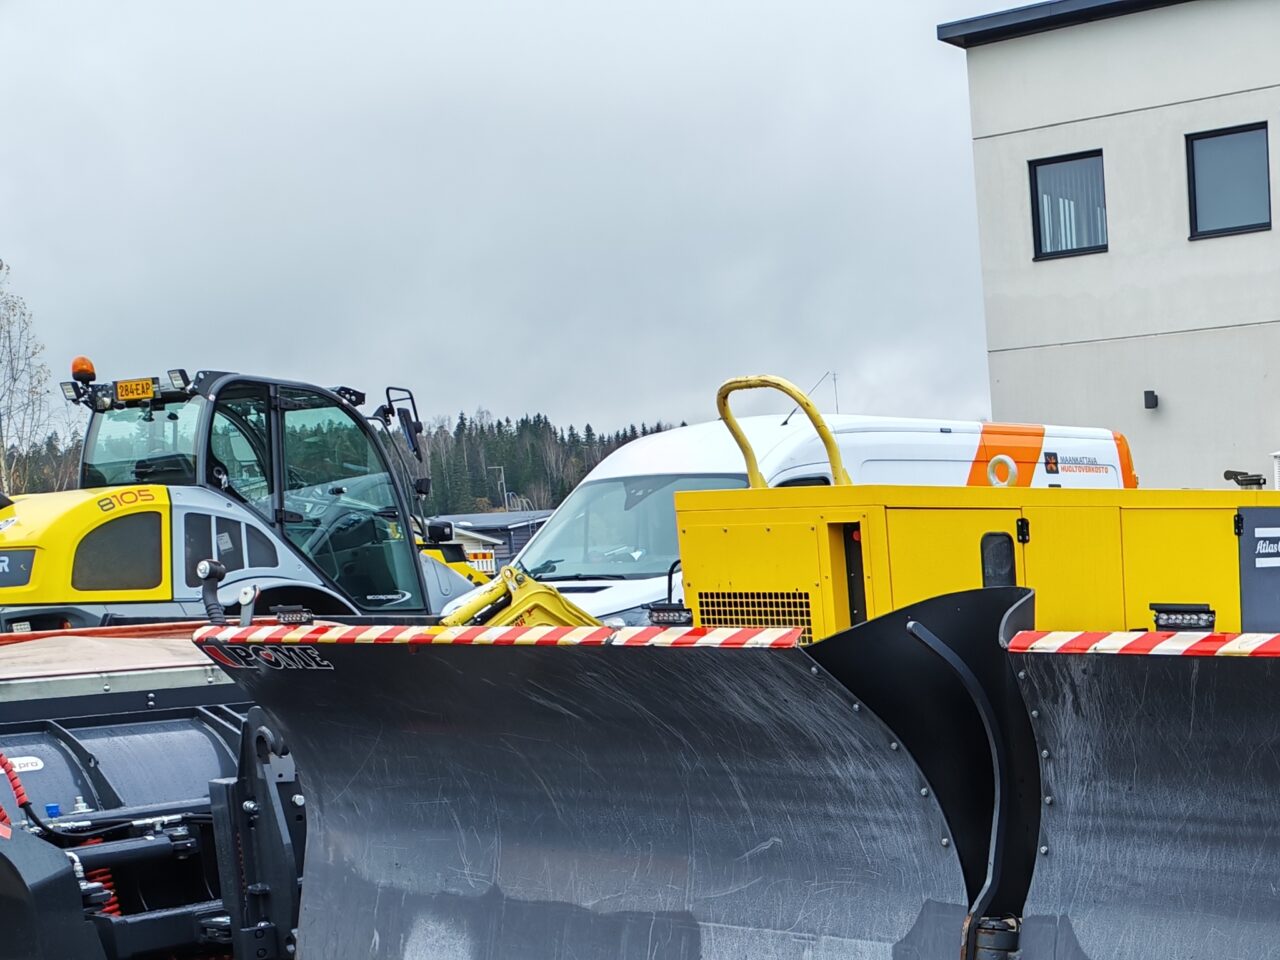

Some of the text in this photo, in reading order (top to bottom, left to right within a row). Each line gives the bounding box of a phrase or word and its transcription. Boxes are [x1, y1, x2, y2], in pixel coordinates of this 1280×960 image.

[97, 489, 155, 512] 8105
[1255, 540, 1277, 554] Atlas
[222, 645, 334, 670] POME
[18, 761, 38, 769] pro
